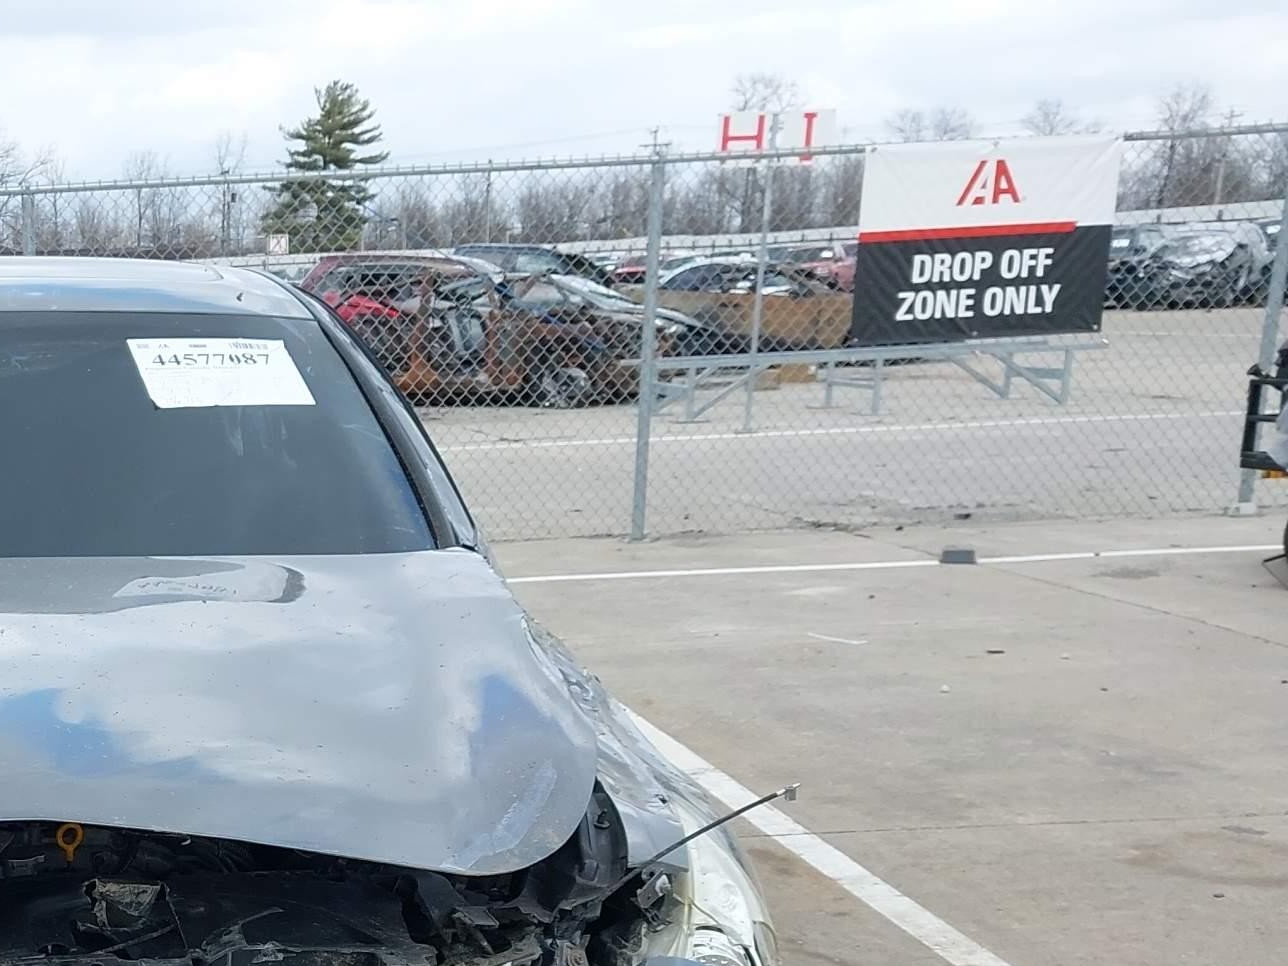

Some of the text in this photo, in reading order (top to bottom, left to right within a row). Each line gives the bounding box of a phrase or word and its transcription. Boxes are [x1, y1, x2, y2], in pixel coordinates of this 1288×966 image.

[911, 247, 1055, 284] DROP OFF
[895, 283, 1062, 321] ZONE ONLY
[152, 352, 270, 366] 44577087
